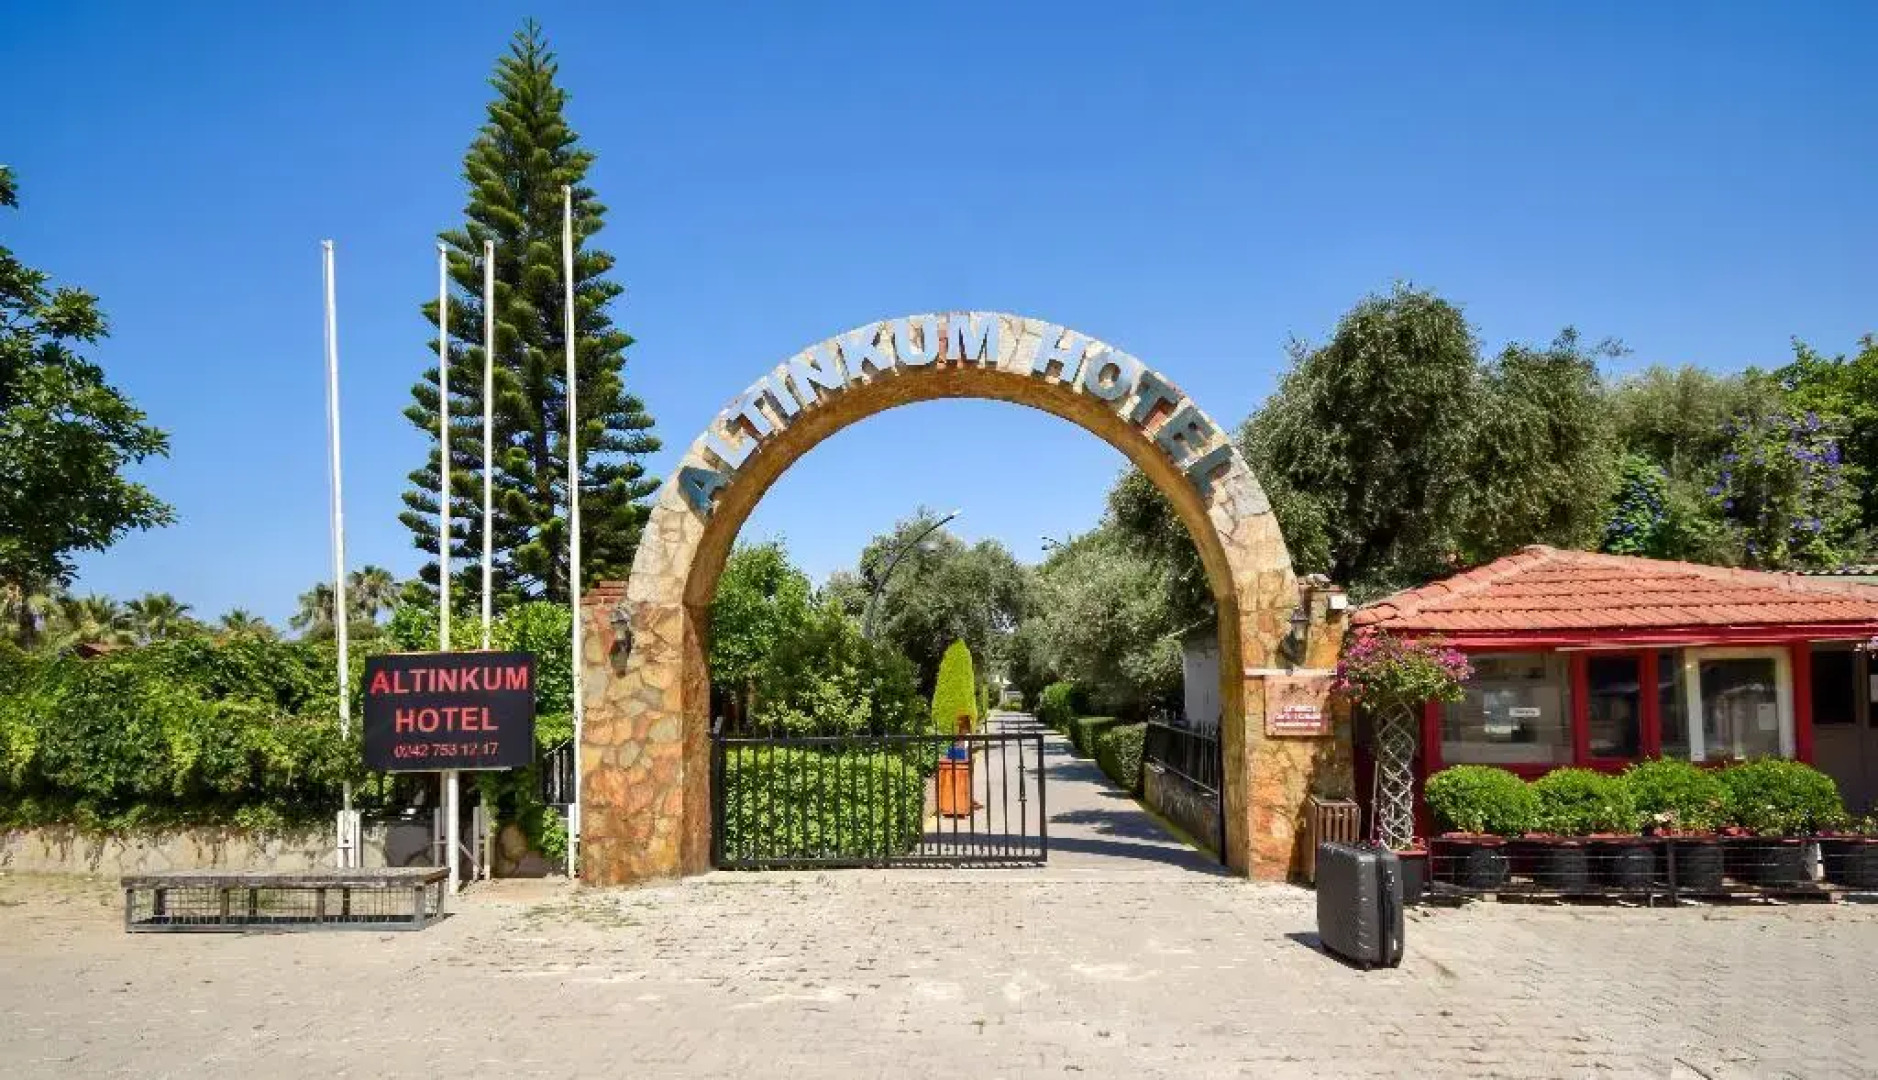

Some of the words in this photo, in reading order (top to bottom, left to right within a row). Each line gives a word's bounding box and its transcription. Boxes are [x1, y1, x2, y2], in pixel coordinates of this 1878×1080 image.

[677, 312, 1000, 515] ALTINKUM
[1030, 321, 1235, 498] HOTEL
[369, 665, 530, 694] ALTINKUM
[394, 707, 500, 733] HOTEL
